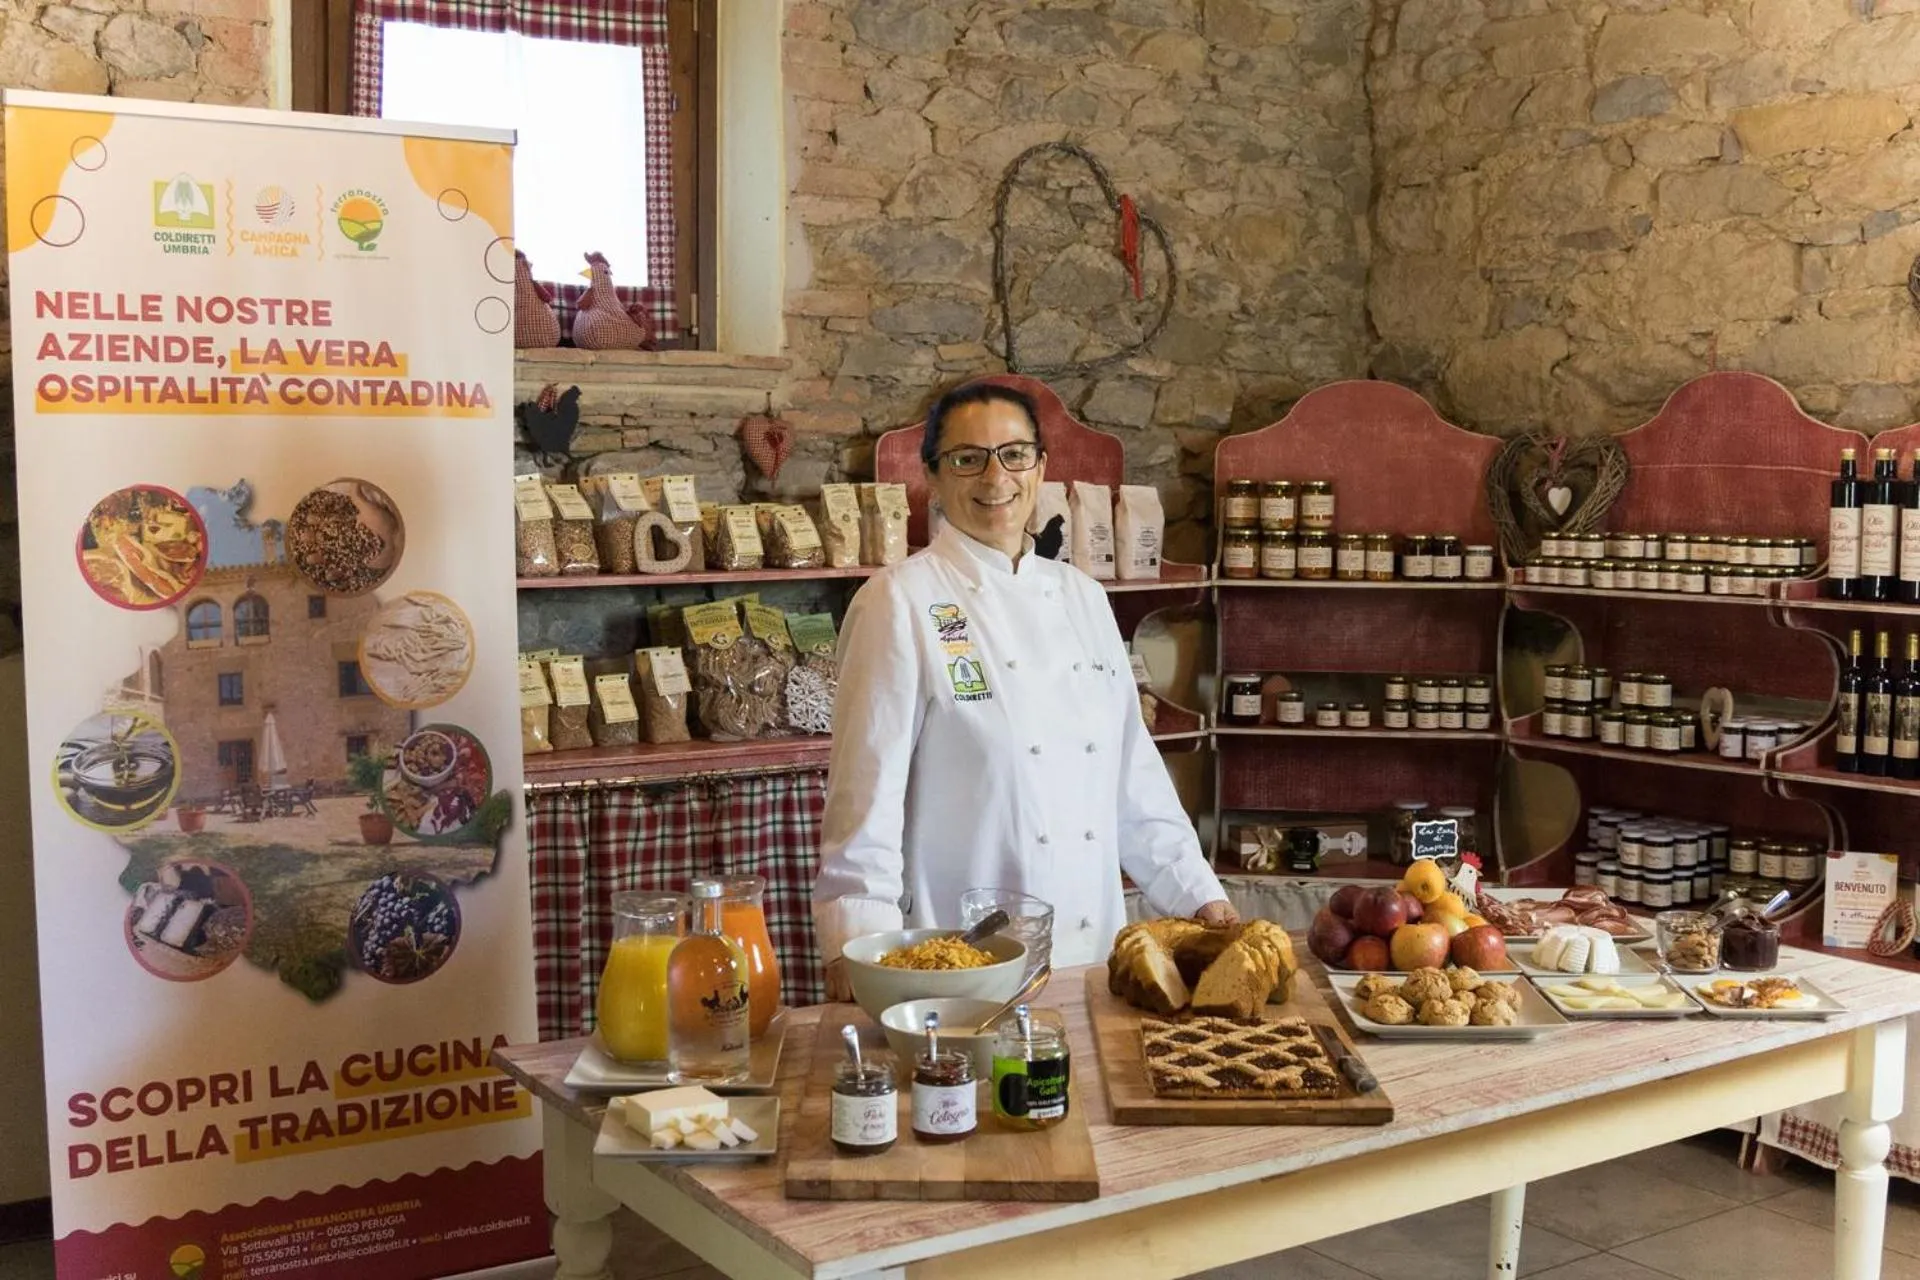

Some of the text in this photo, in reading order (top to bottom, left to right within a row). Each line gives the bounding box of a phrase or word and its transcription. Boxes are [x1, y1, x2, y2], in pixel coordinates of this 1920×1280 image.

[153, 231, 216, 245] COLDIRETTI
[163, 243, 210, 256] UMBRIA
[240, 230, 311, 245] CAMPAGNA
[253, 244, 299, 257] AMICA
[35, 290, 333, 328] NELLE NOSTRE
[36, 331, 399, 370] AZIENDE, LA VERA
[38, 372, 493, 409] OSPITALITÀ CONTADINA
[953, 691, 993, 702] COLDIRETTI
[1834, 881, 1887, 895] BENVENUTO
[67, 1034, 511, 1128] SCOPRI LA CUCINA
[67, 1079, 519, 1180] DELLA TRADIZIONE
[220, 1199, 422, 1244] Associazione TERRANOSTRA UMBRIA
[221, 1246, 240, 1257] Via
[241, 1234, 289, 1252] Settevalli
[361, 1213, 406, 1231] PERUGIA
